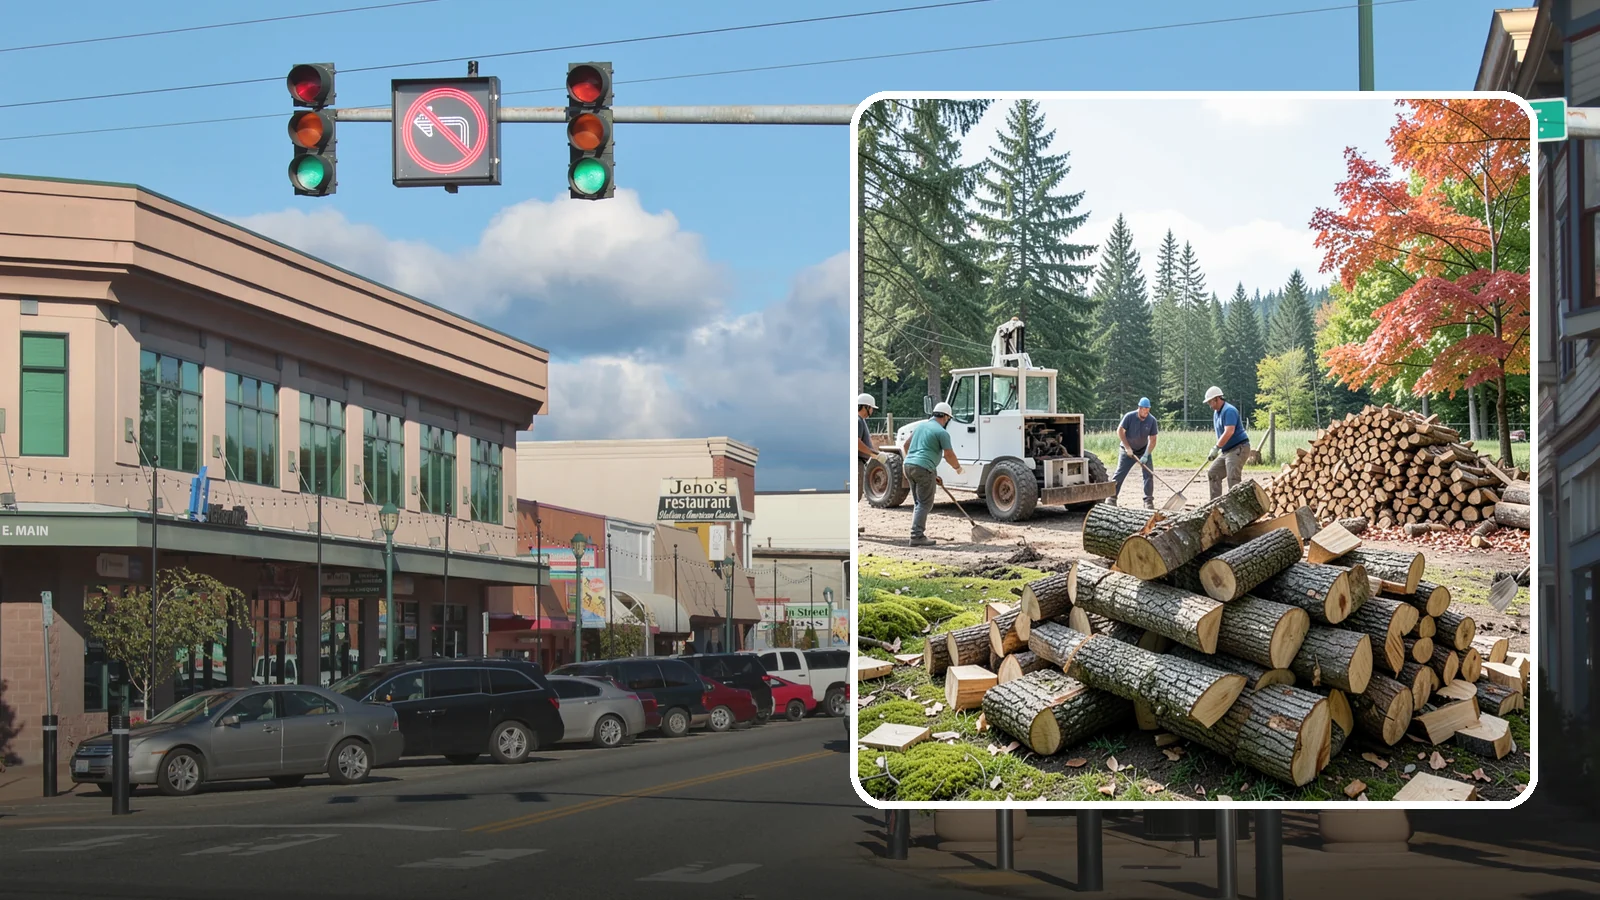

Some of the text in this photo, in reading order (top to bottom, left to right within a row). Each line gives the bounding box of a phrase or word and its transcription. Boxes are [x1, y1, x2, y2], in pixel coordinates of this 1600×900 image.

[670, 480, 727, 494] Jeno's
[665, 496, 731, 509] restaurant
[659, 510, 681, 519] Italian
[686, 510, 714, 519] American
[715, 510, 737, 519] Cuisine
[2, 525, 49, 536] E. MAIN
[797, 608, 828, 617] Street
